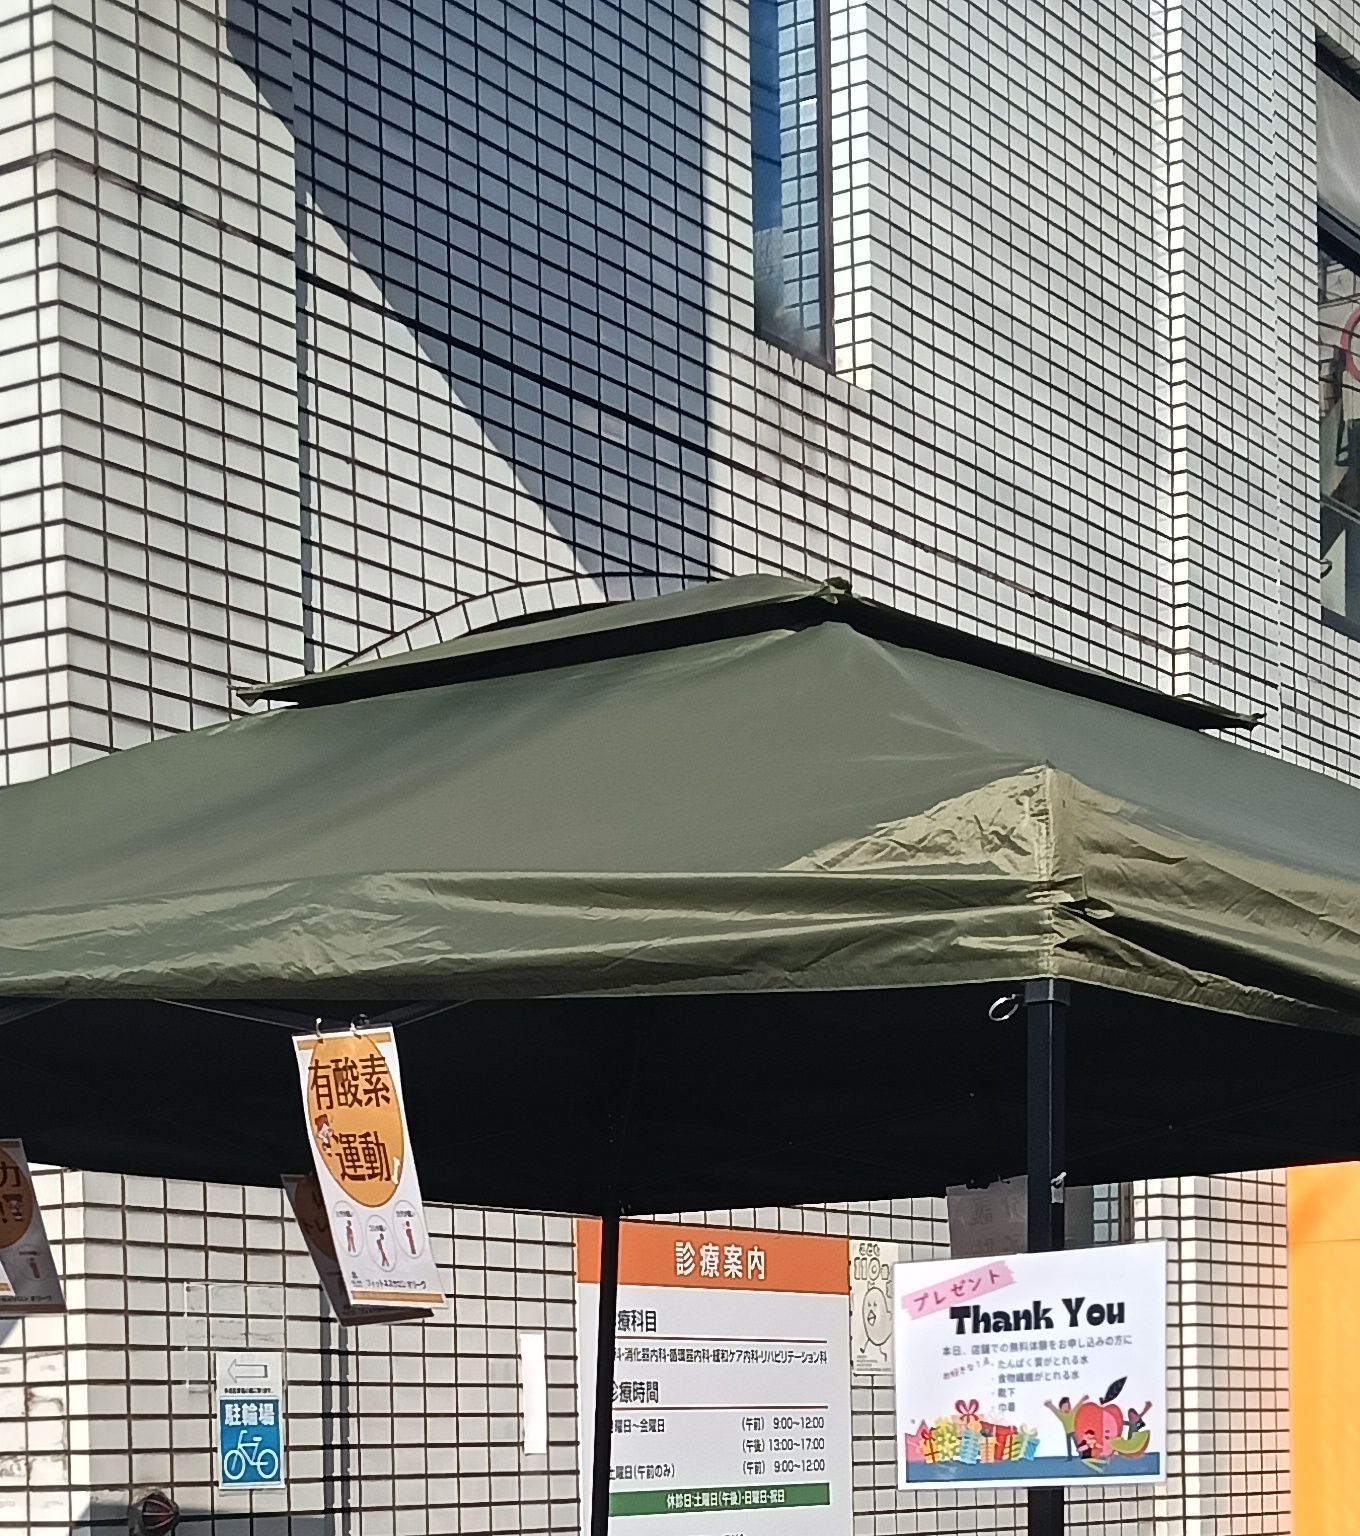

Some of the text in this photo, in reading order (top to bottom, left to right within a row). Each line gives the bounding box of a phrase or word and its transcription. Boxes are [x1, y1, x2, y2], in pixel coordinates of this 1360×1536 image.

[308, 1053, 391, 1110] 有酸素
[332, 1131, 392, 1182] 運動
[674, 1240, 767, 1281] 診療案内
[912, 1268, 1001, 1313] プレゼント
[615, 1310, 658, 1332] 療科目
[950, 1296, 1126, 1335] Thank You
[224, 1402, 275, 1426] 駐輪場
[611, 1418, 666, 1434] 曜日～金曜日
